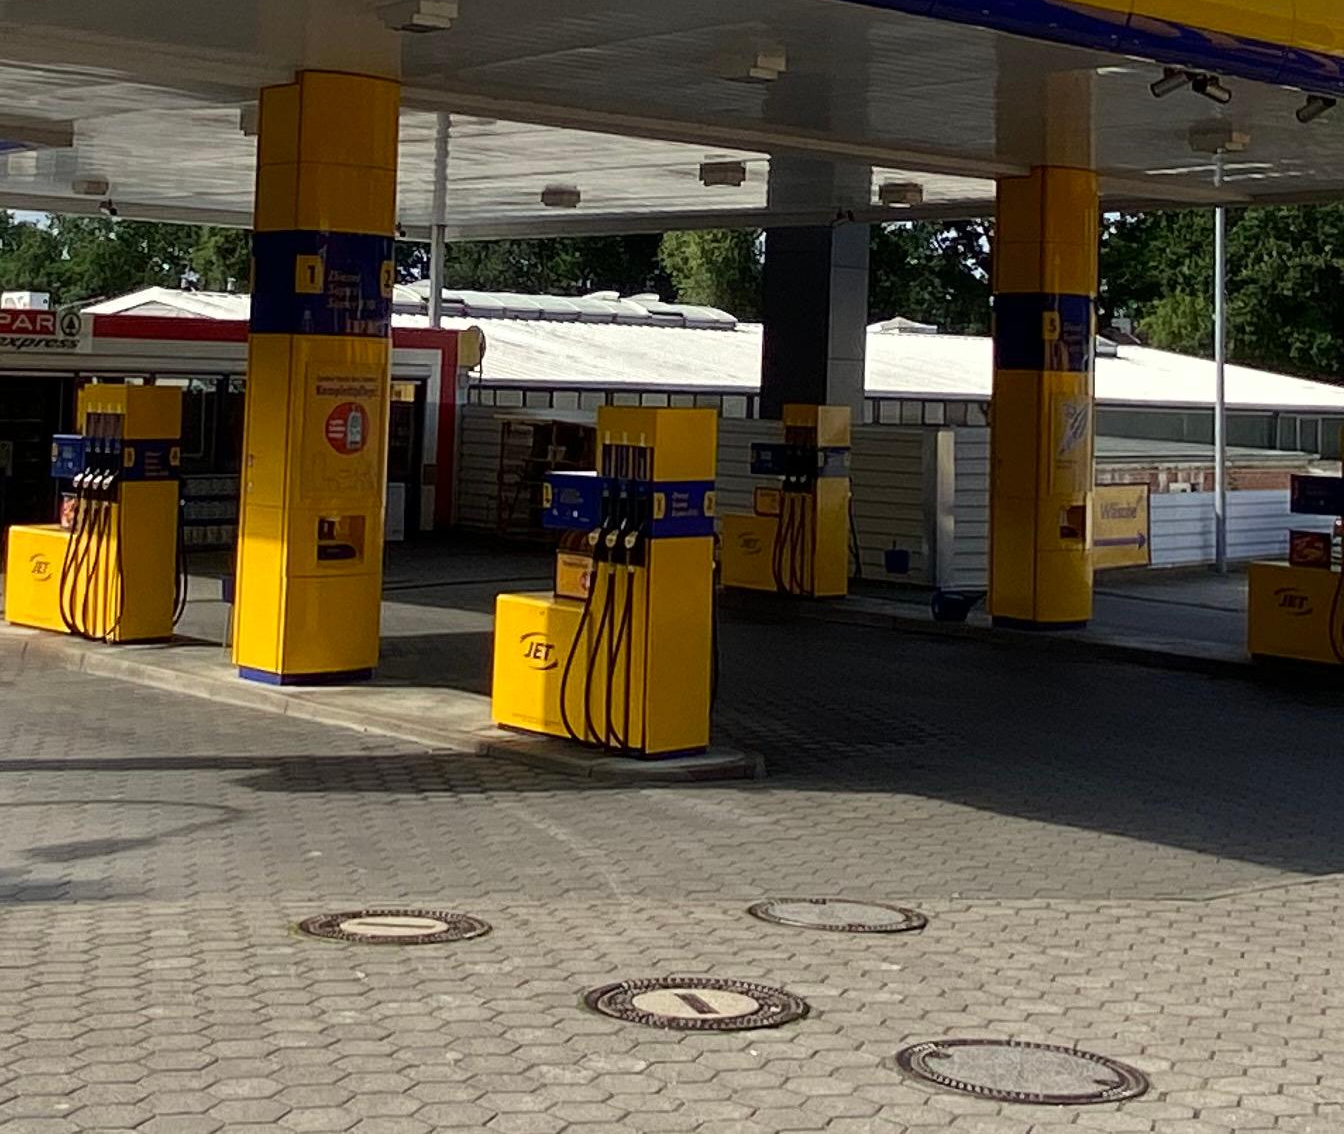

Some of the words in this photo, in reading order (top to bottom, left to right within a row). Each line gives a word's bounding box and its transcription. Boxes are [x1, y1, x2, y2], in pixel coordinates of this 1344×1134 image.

[307, 265, 317, 284] 1
[382, 268, 392, 288] 2
[524, 642, 555, 661] JET
